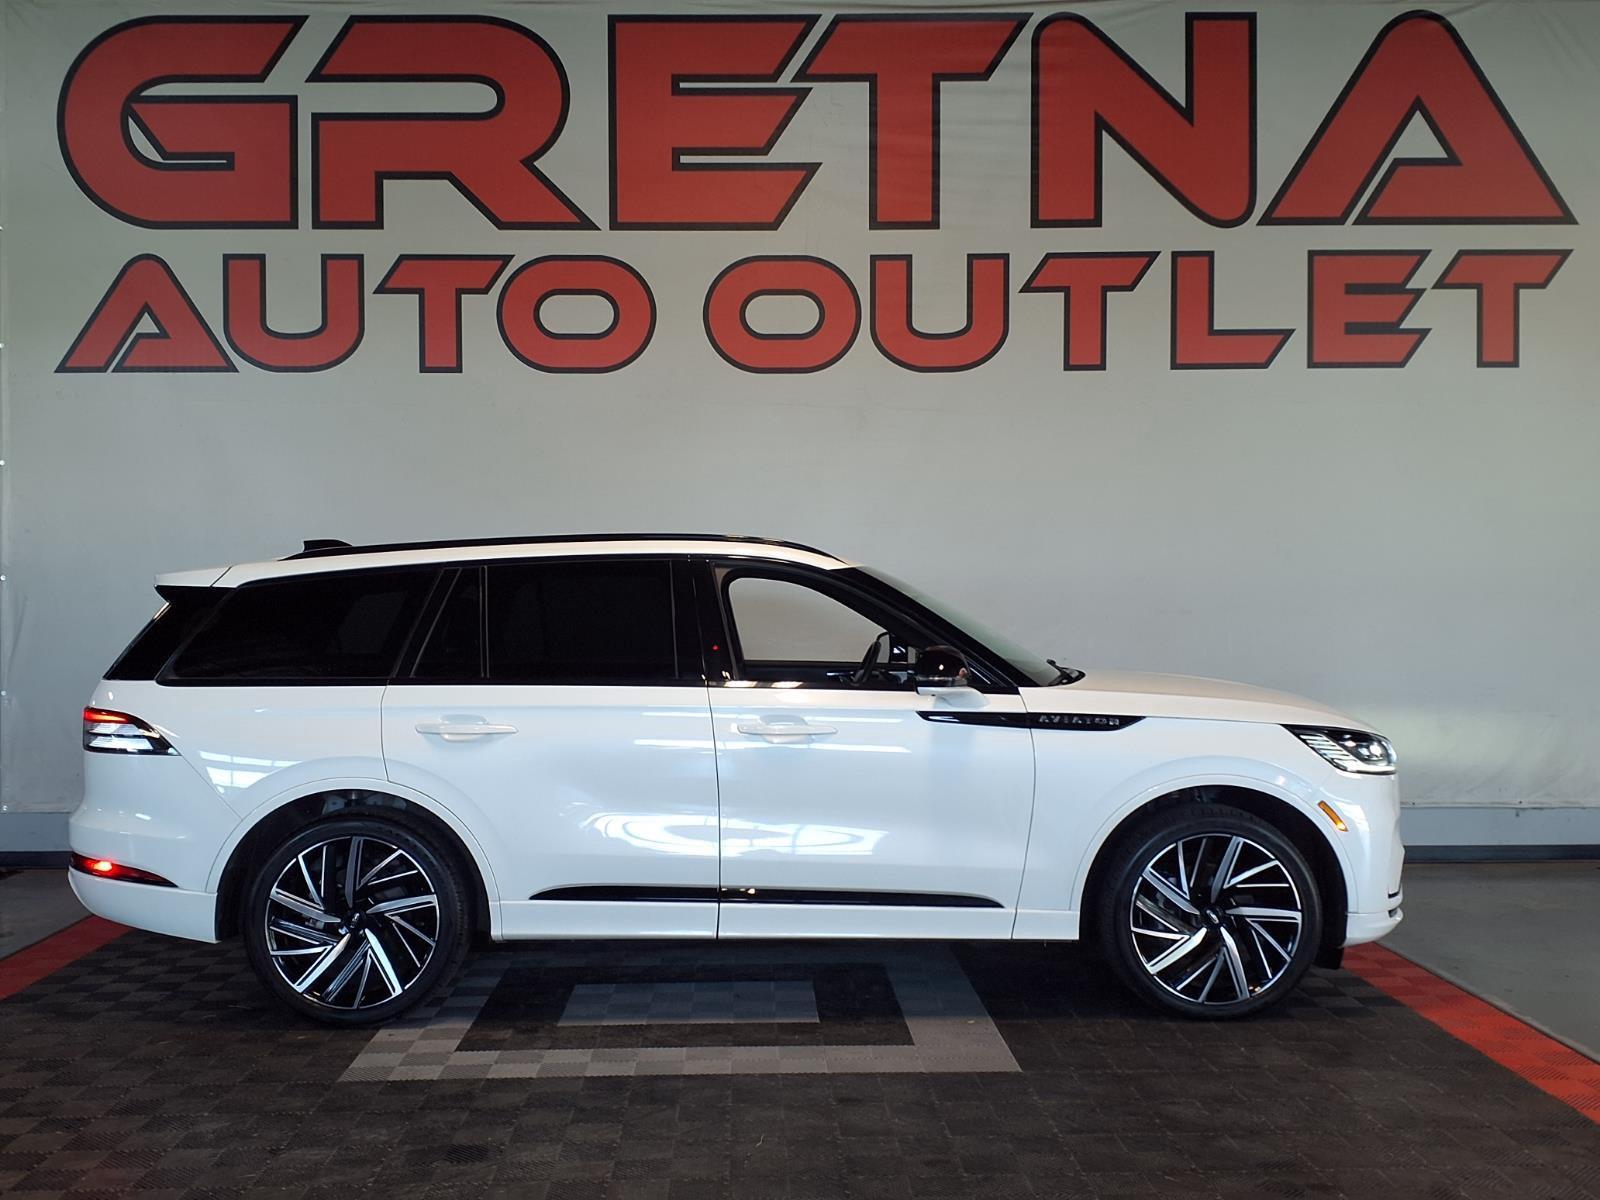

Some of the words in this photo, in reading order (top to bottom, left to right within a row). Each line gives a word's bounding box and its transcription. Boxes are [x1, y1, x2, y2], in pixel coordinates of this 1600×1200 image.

[57, 9, 1577, 231] GRETNA
[54, 253, 657, 374] AUTO
[703, 249, 1573, 374] OUTLET
[1039, 714, 1120, 726] AVIATOR
